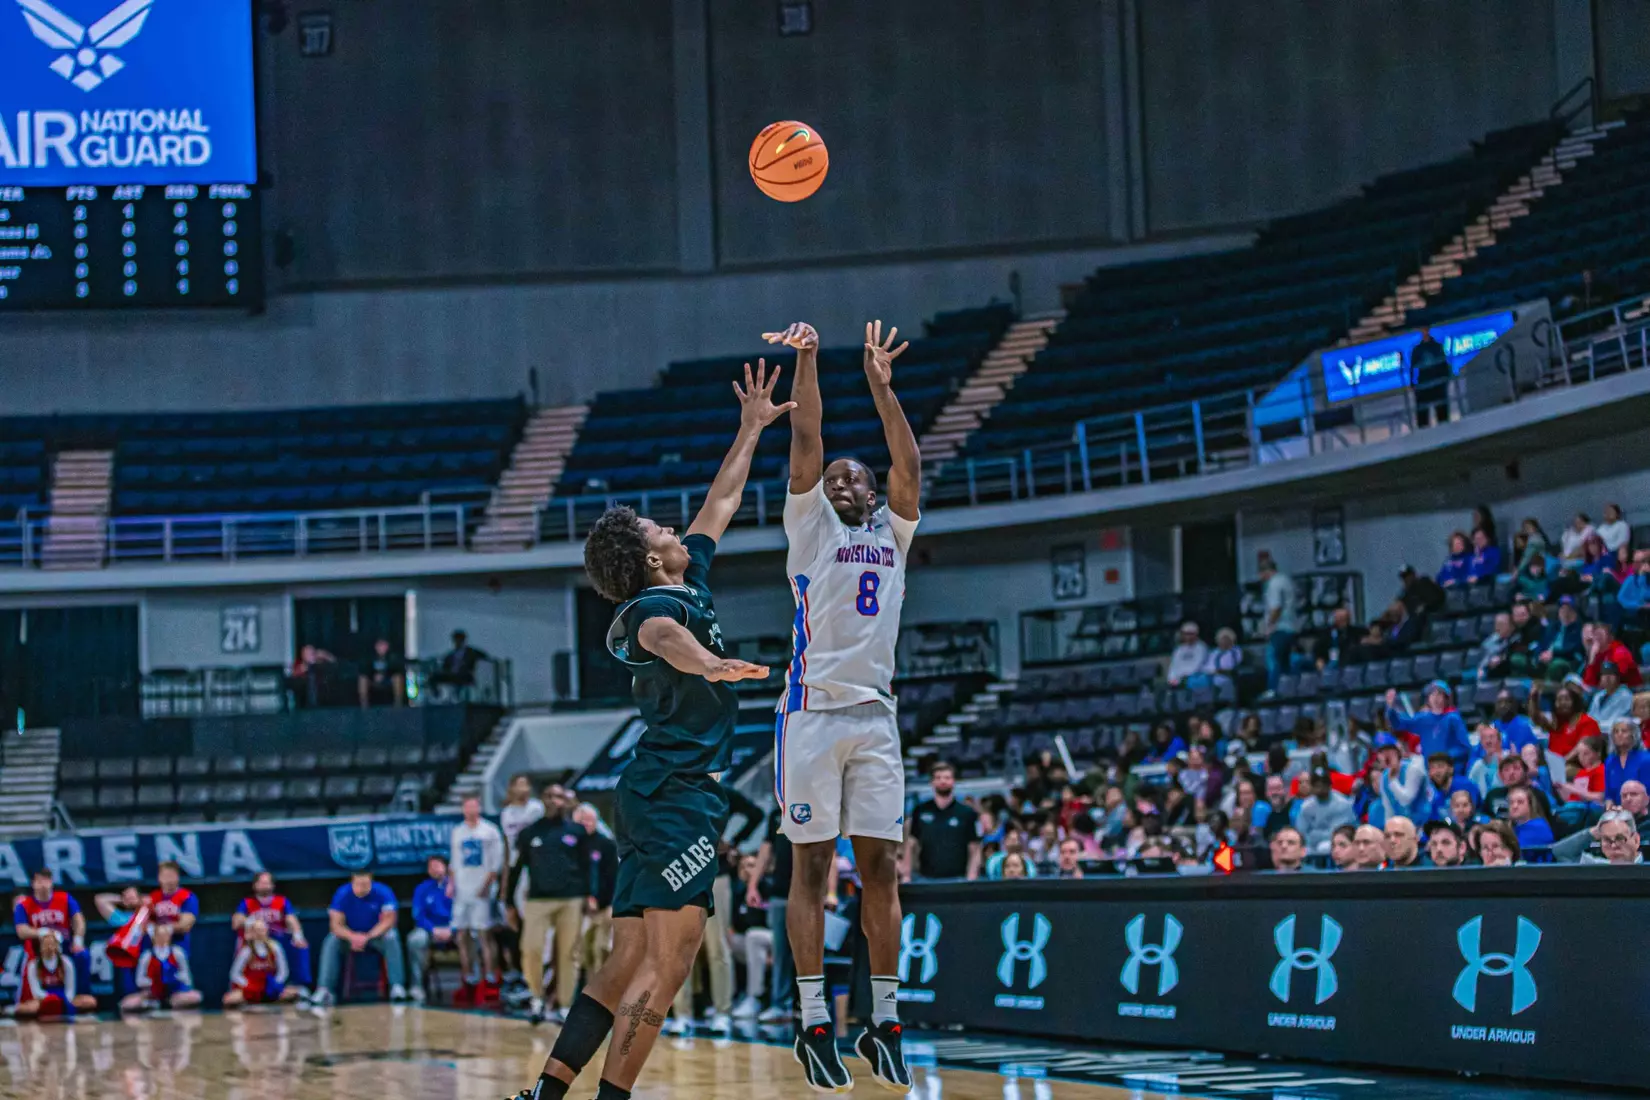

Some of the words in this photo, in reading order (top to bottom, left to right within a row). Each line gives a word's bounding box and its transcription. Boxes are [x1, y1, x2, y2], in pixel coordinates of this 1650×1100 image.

[80, 109, 209, 132] NATIONAL
[79, 134, 212, 168] GUARD
[856, 570, 880, 617] 8
[661, 835, 715, 892] BEARS
[1267, 1012, 1297, 1028] UNDER
[1297, 1015, 1337, 1031] ARMOUR
[1451, 1024, 1487, 1041] UNDER
[1487, 1027, 1536, 1045] ARMOUR
